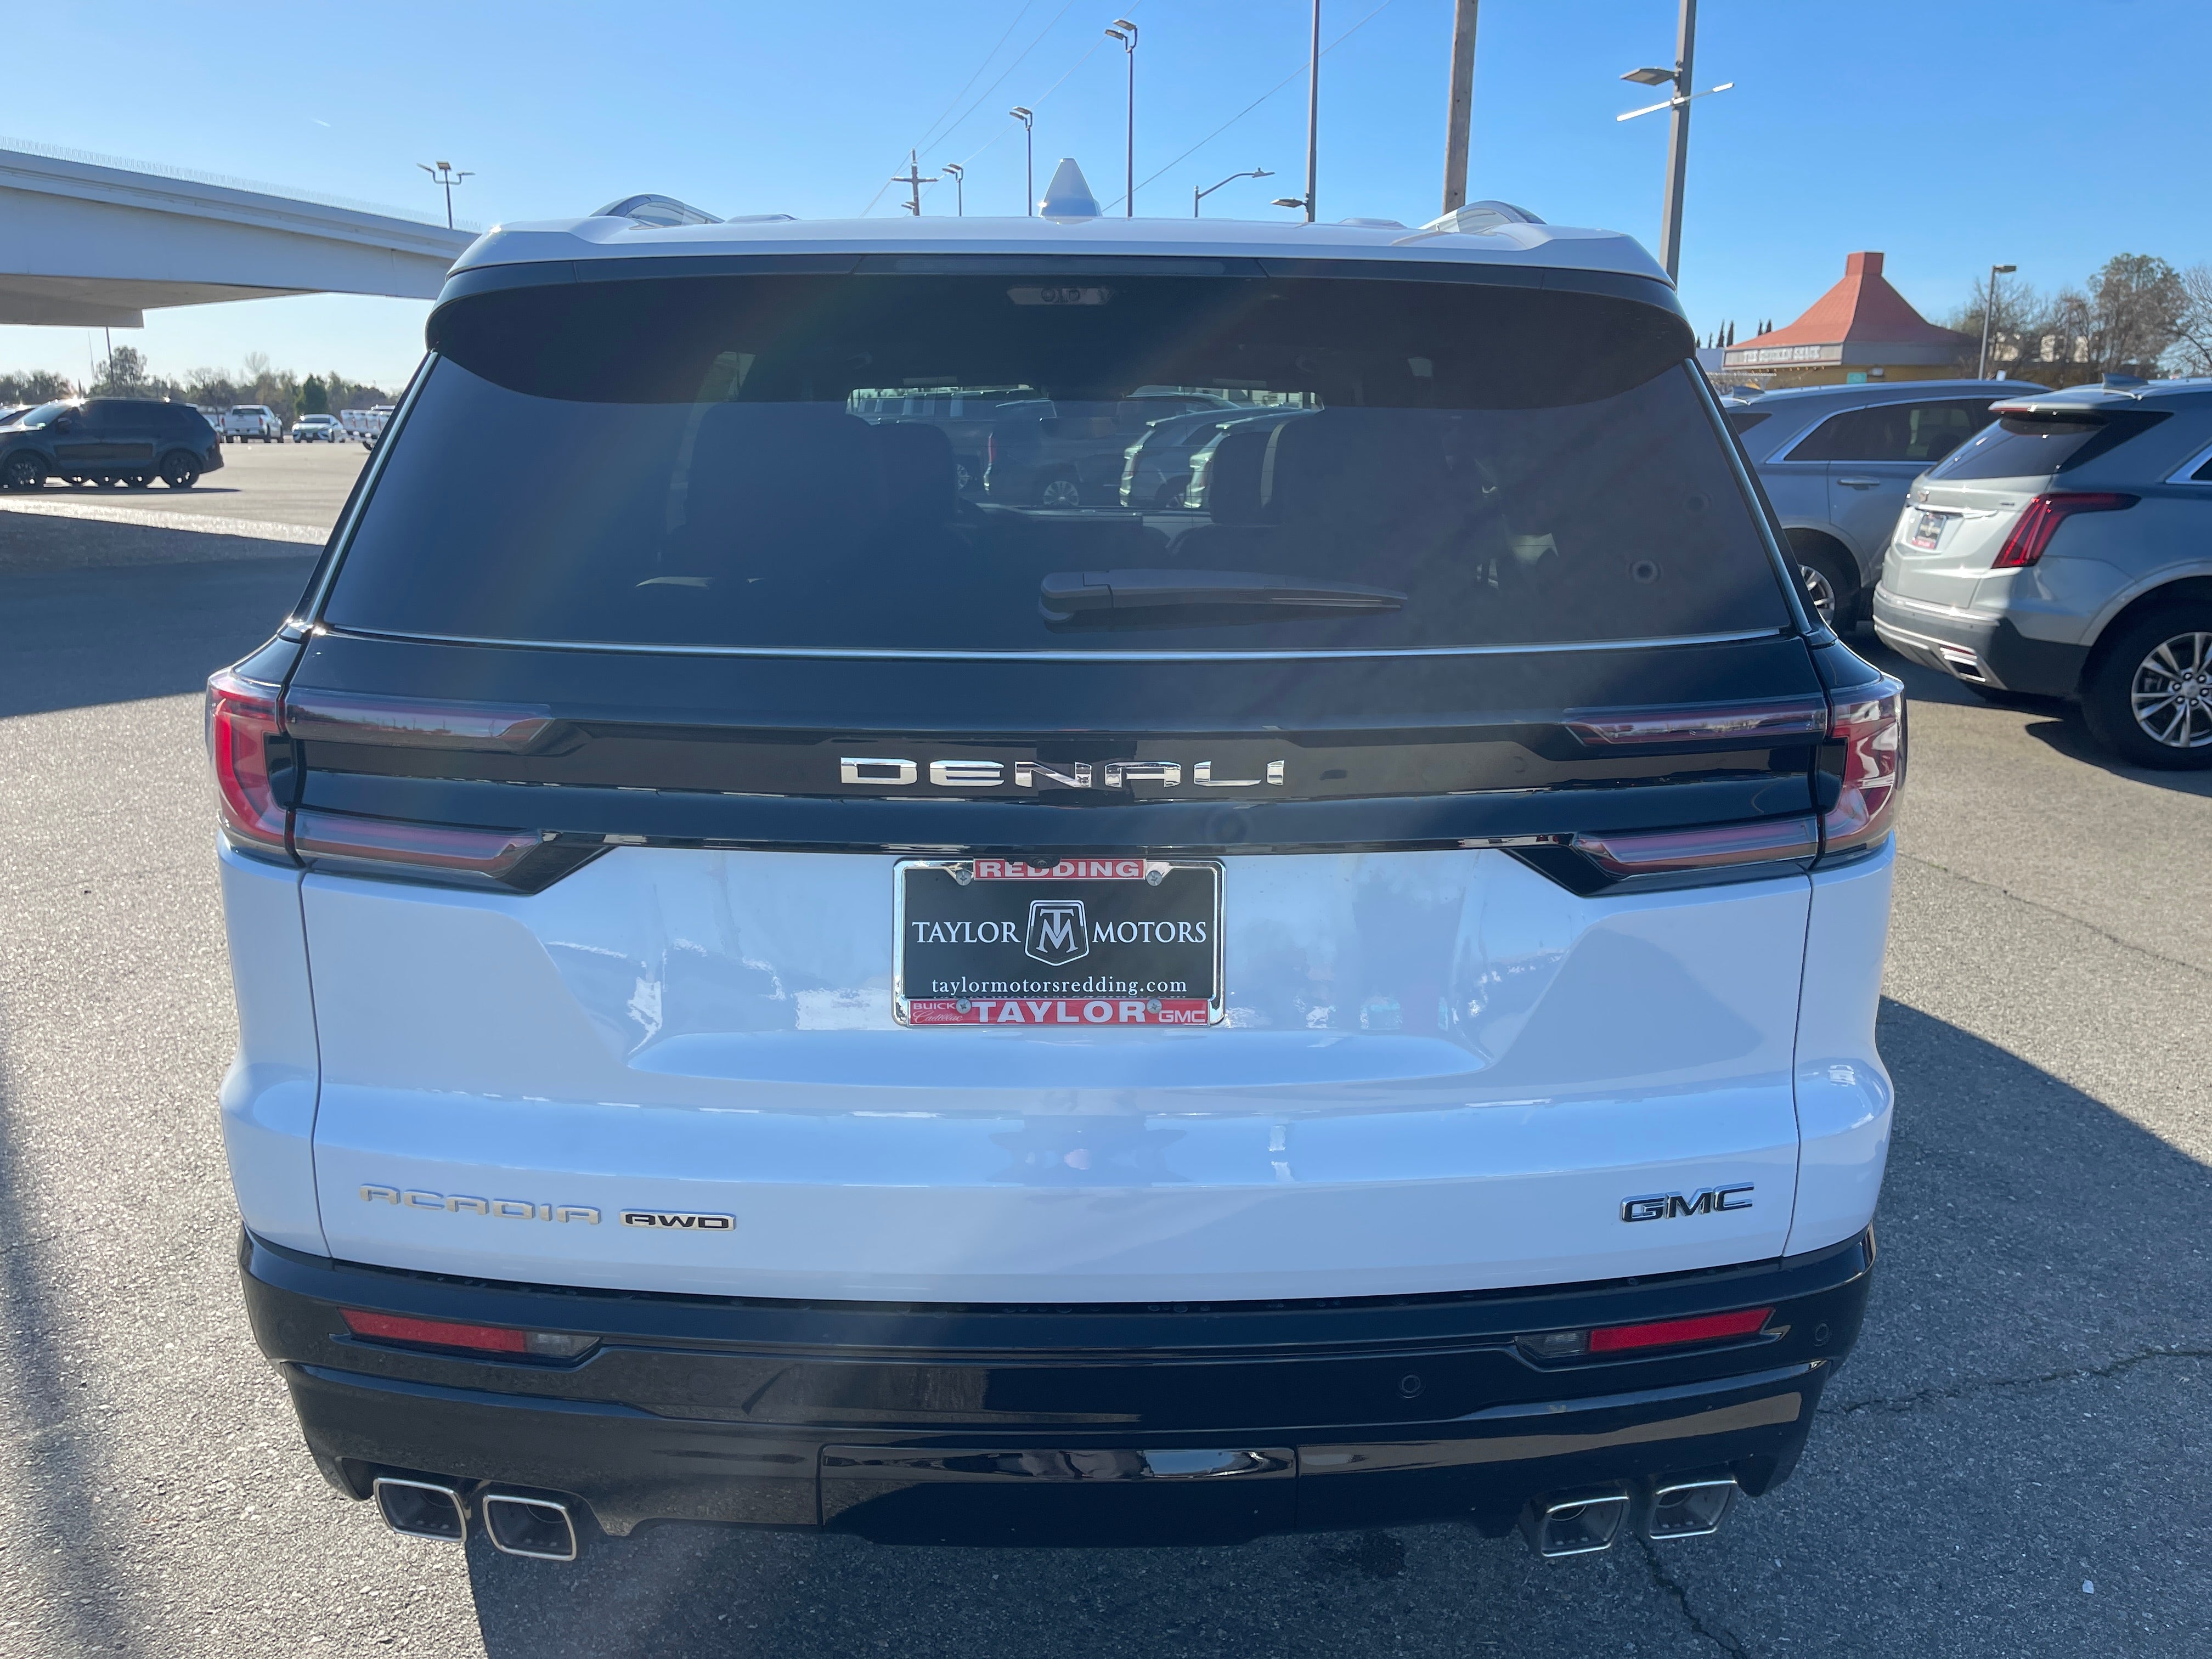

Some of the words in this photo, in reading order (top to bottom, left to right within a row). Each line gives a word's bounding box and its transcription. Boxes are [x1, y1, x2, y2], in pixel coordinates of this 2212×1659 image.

[840, 758, 1284, 788] DENALI
[980, 861, 1139, 877] REDDING
[911, 921, 1021, 944] TAYLOR
[1092, 921, 1207, 944] MOTORS
[932, 976, 1187, 995] taylormotorsredding.com
[913, 1010, 963, 1024] Cadillac
[971, 1001, 1147, 1023] TAYLOR
[1159, 1010, 1205, 1023] GMC
[360, 1183, 602, 1225] ACADIA
[624, 1212, 731, 1230] AWD
[1620, 1181, 1755, 1223] GMC
